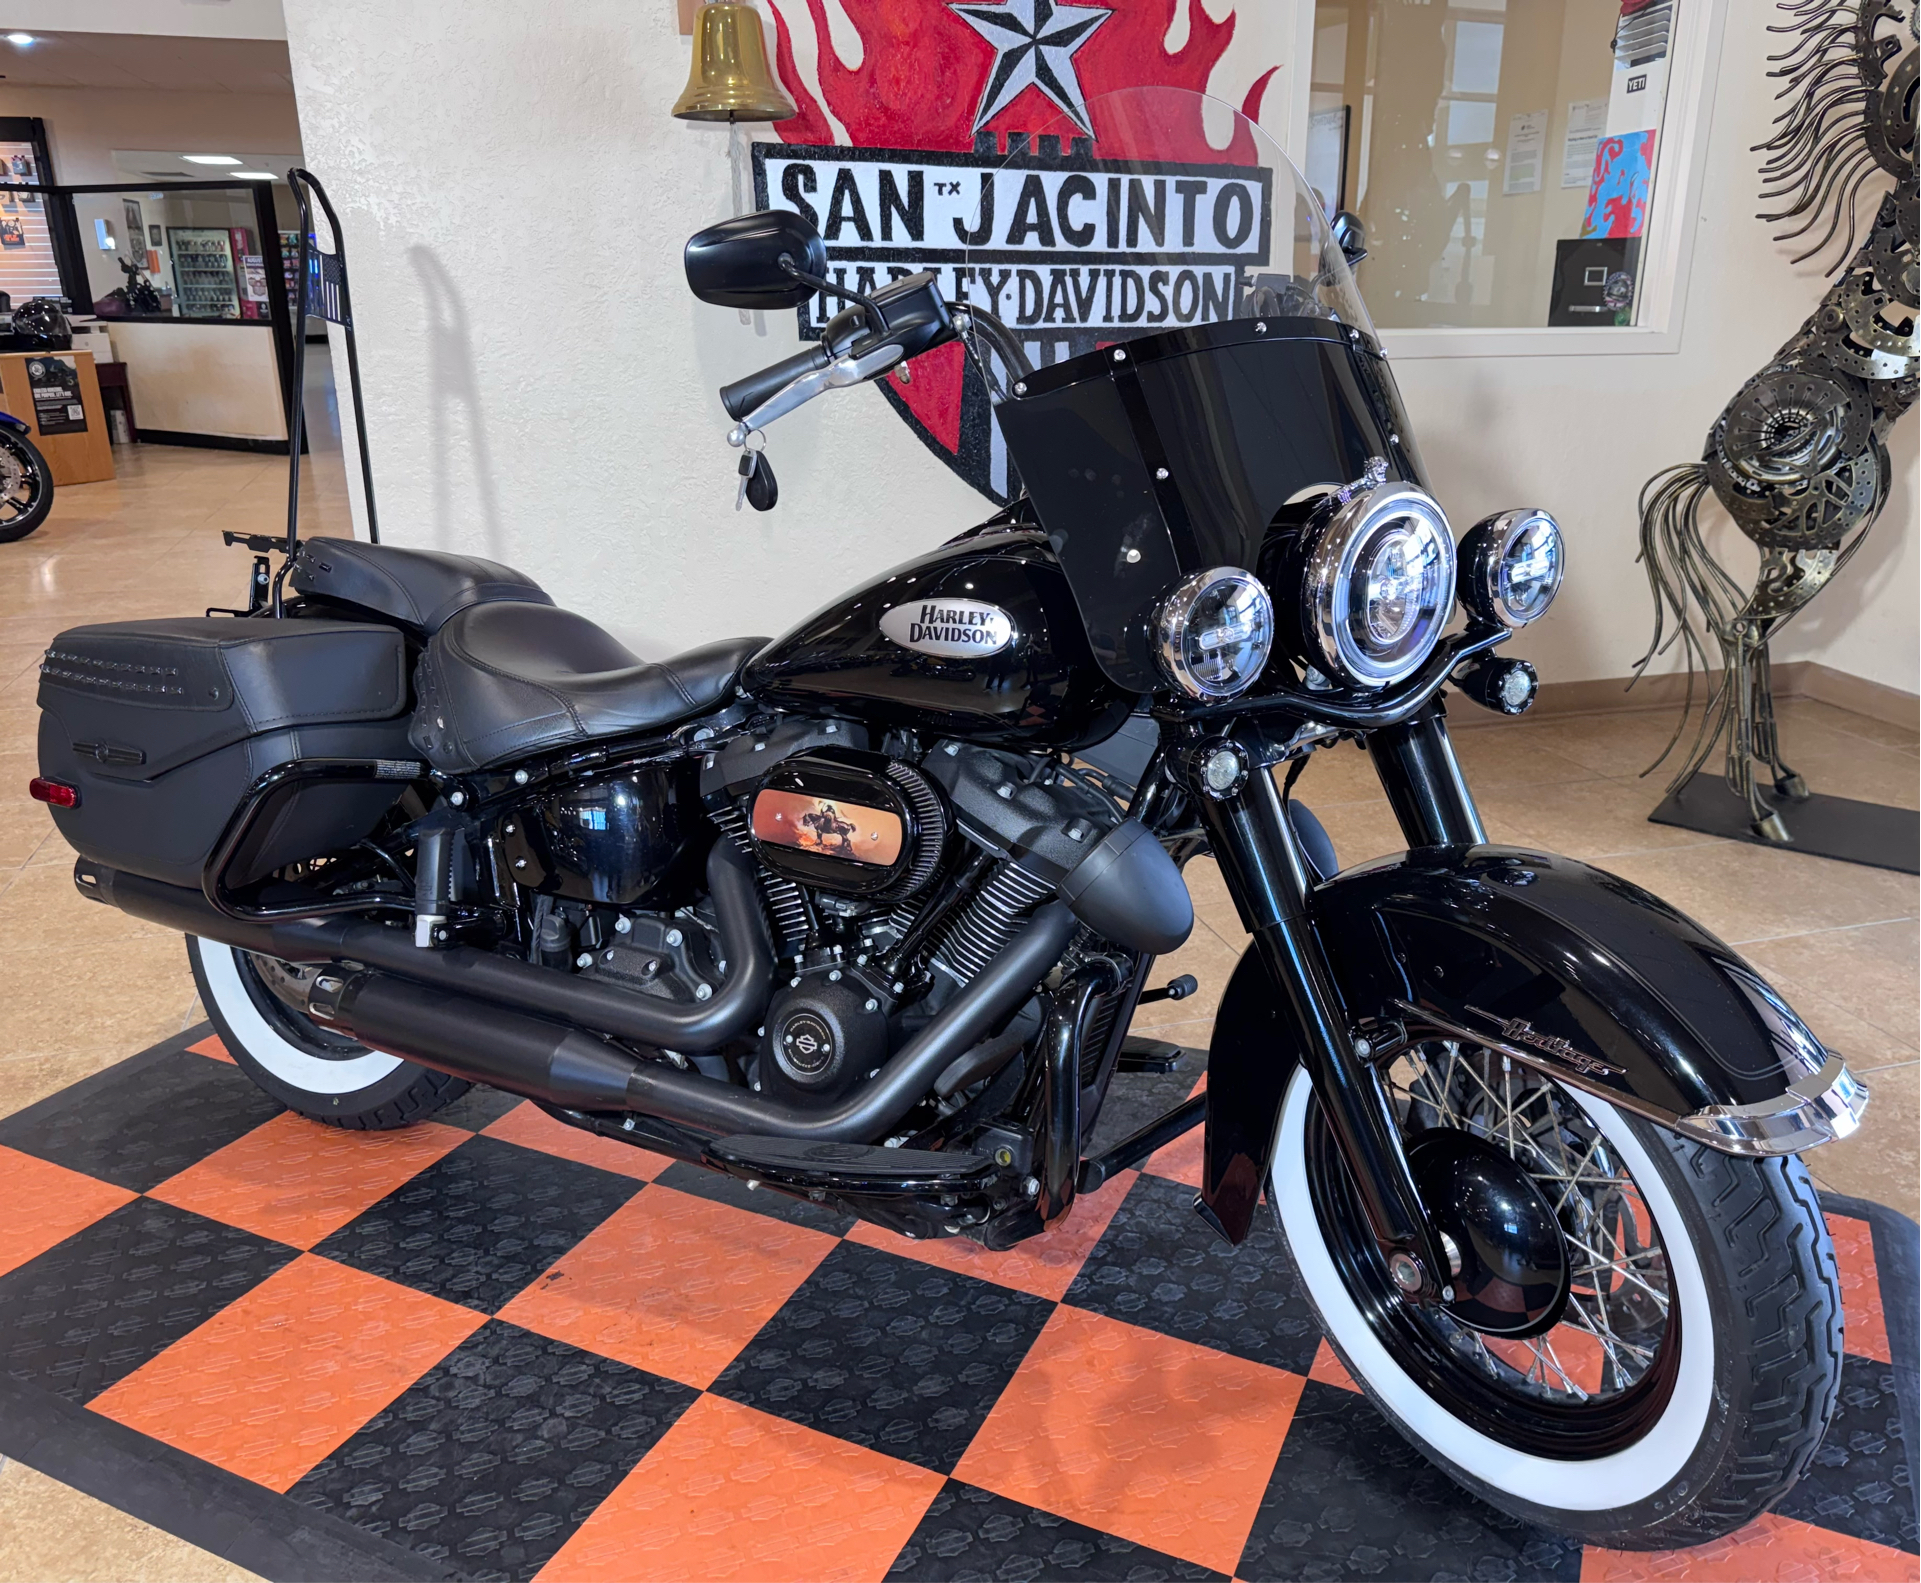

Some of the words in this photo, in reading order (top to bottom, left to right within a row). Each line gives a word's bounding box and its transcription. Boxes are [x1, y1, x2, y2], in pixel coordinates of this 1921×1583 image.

[1628, 77, 1646, 91] YETI
[781, 162, 925, 242] SAN
[933, 181, 961, 196] TX
[952, 172, 1255, 250] JACINTO
[909, 623, 997, 645] DAVIDSON
